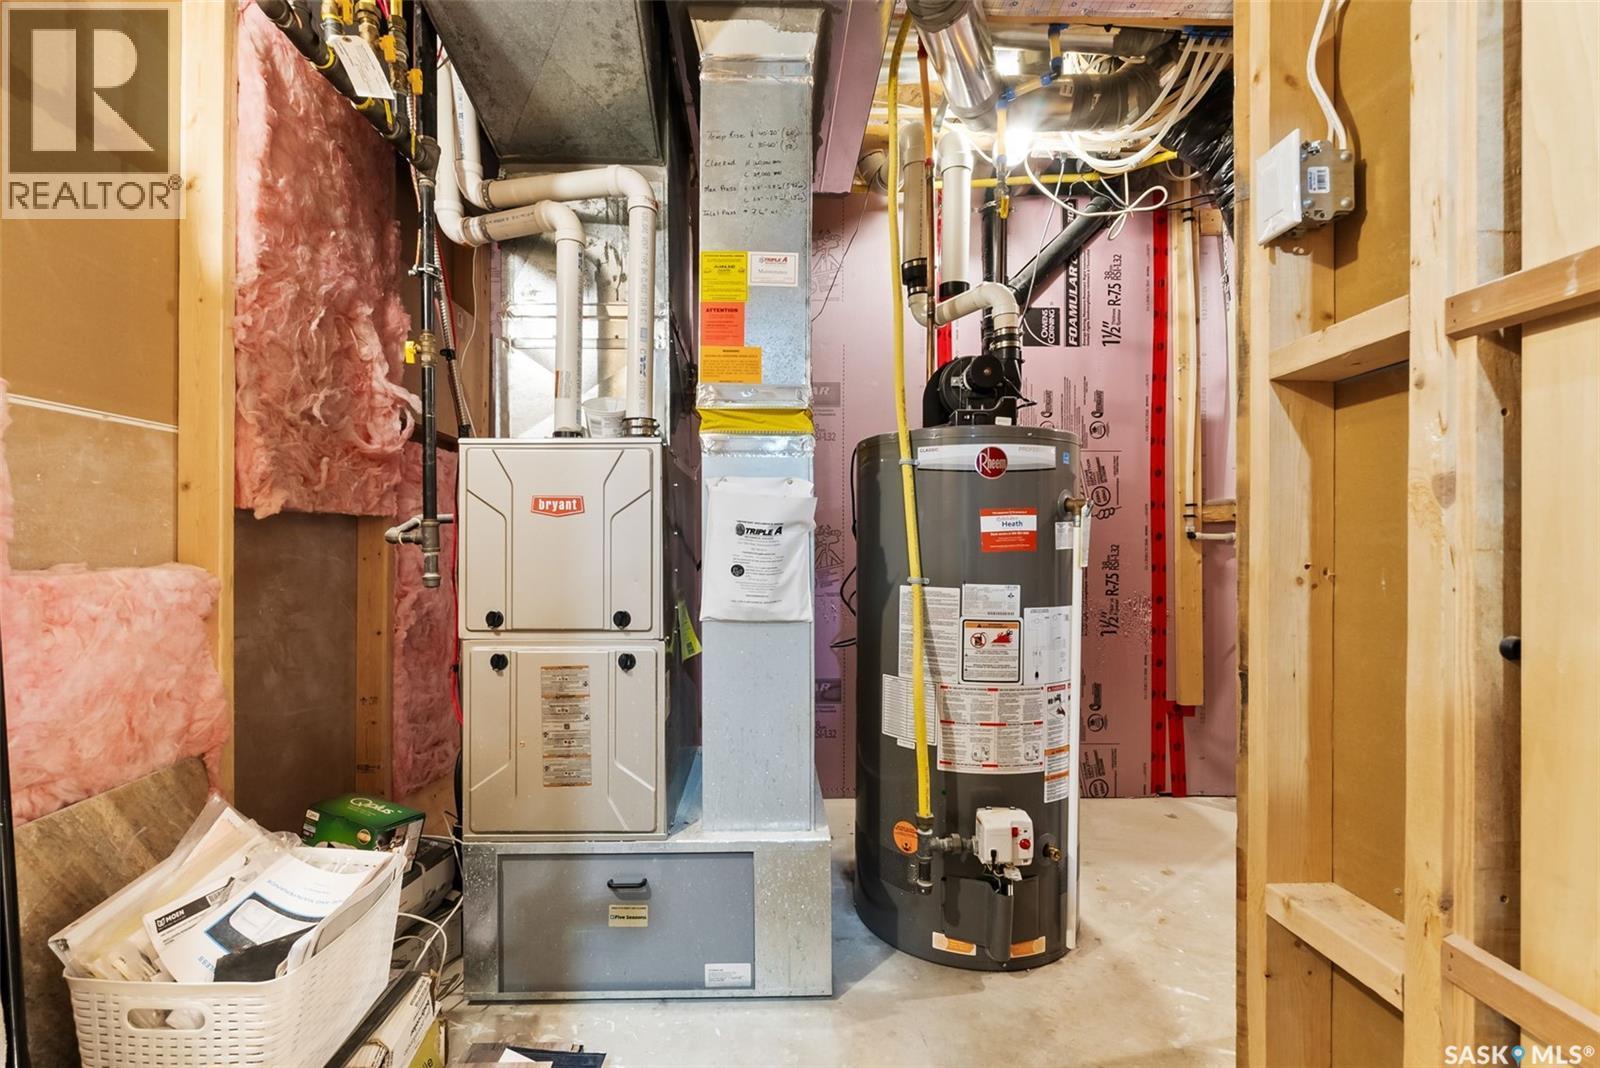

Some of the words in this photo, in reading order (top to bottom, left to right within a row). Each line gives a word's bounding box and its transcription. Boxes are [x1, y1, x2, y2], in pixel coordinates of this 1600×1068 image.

[1068, 267, 1078, 346] FOAMULAR
[979, 447, 1006, 474] Rheem
[538, 498, 578, 512] bryant
[745, 527, 774, 536] TRIPLE
[774, 526, 783, 535] A
[165, 909, 185, 923] MOEN
